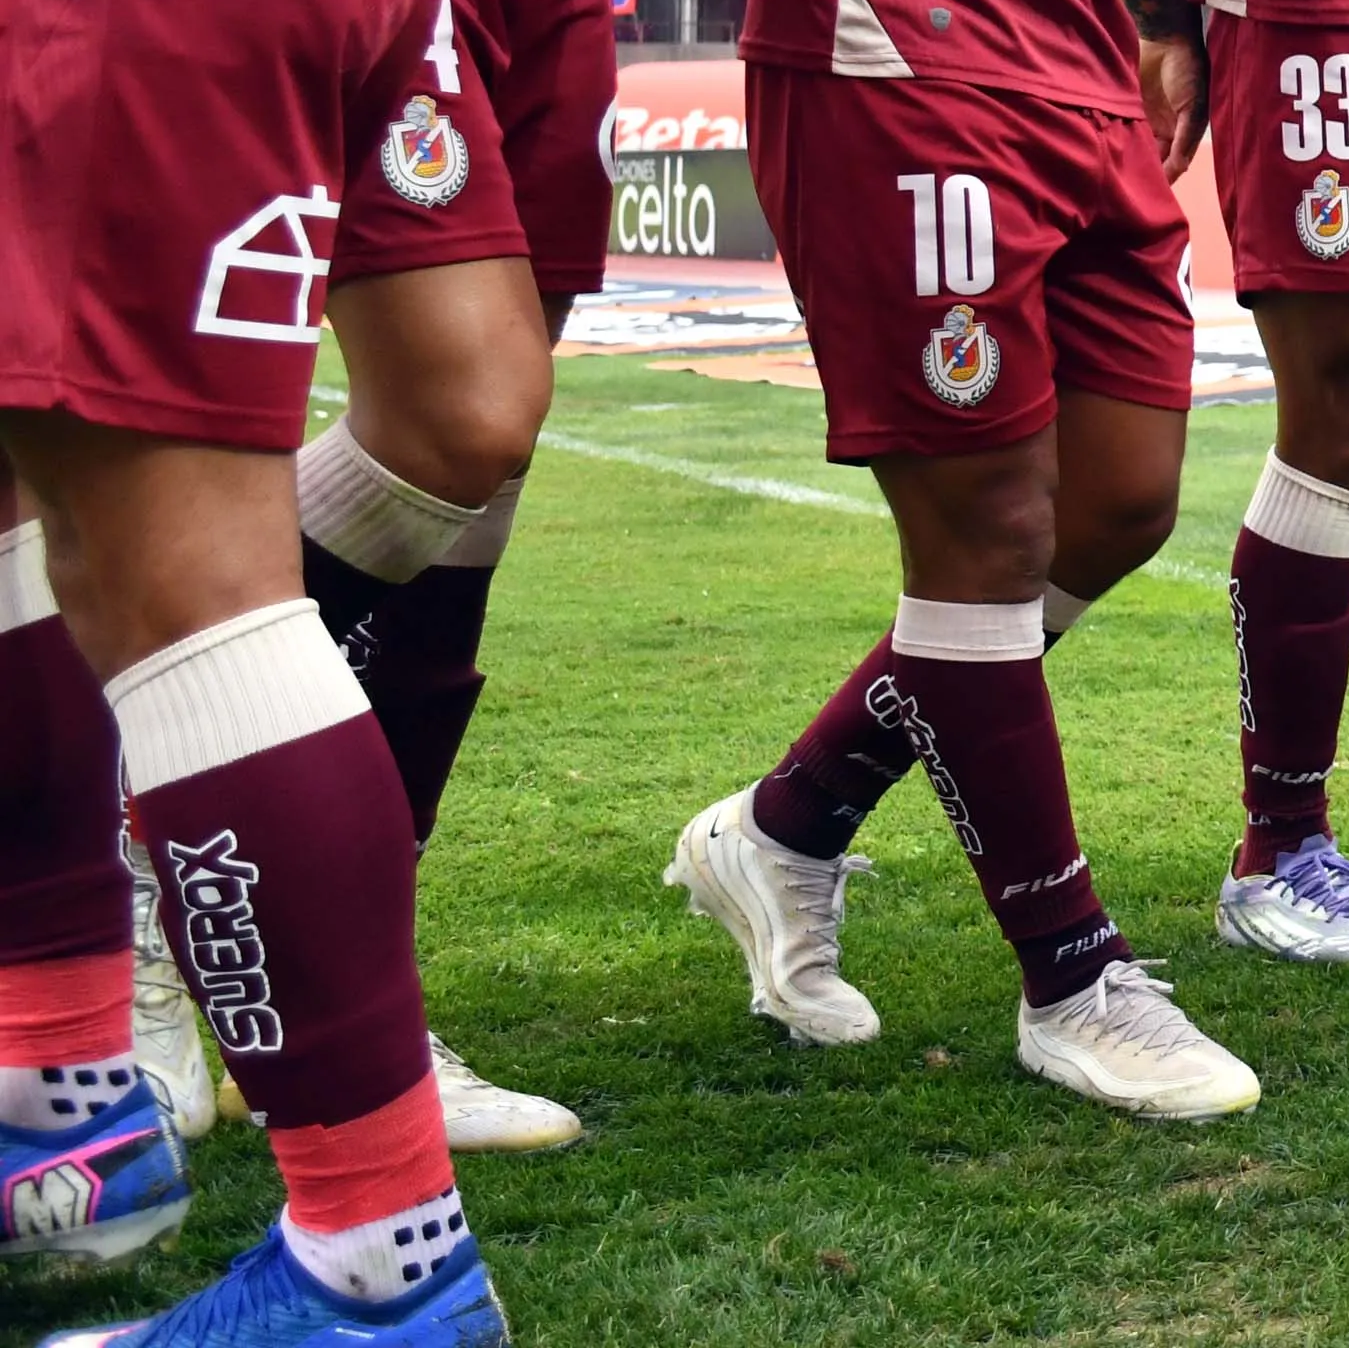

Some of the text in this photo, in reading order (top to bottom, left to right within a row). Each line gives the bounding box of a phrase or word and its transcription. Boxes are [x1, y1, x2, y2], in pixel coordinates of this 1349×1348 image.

[616, 107, 747, 151] Beta
[618, 155, 716, 256] celta
[897, 173, 995, 296] 10
[168, 829, 284, 1052] SUEROX
